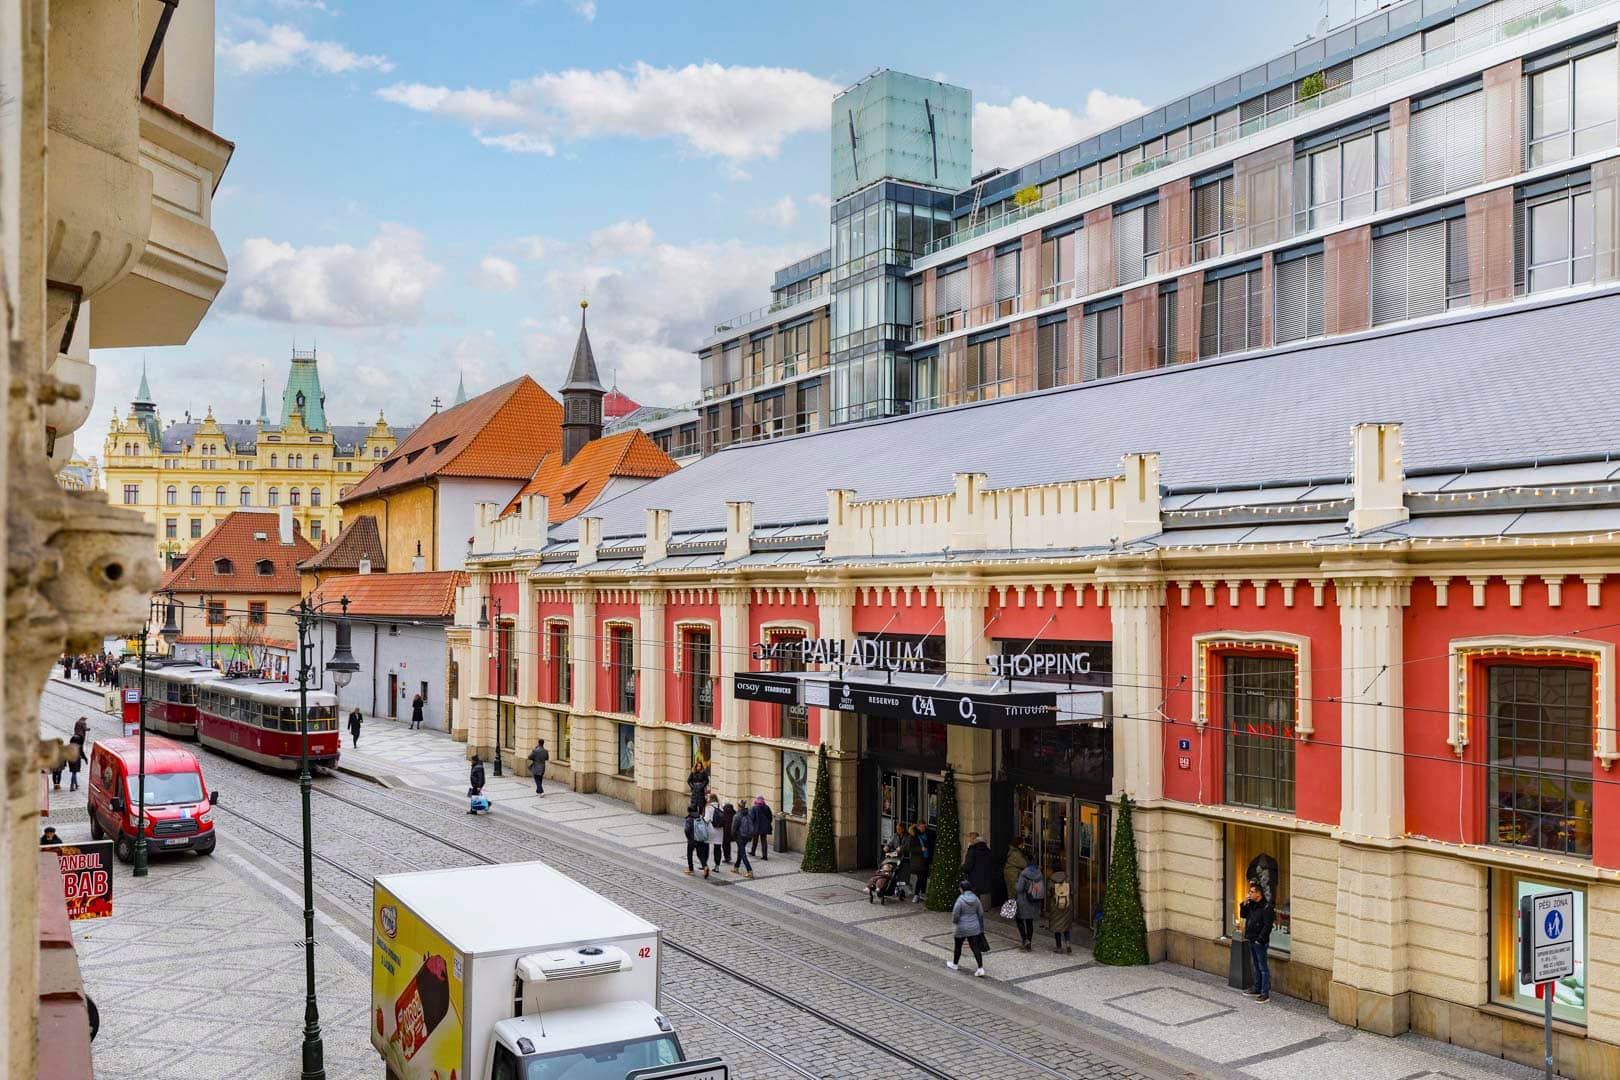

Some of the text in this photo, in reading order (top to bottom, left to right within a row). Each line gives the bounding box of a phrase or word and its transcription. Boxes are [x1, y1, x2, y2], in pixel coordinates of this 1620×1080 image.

[801, 638, 926, 673] PALLADIUM
[986, 652, 1091, 676] SHOPPING
[737, 681, 760, 695] orsay
[868, 696, 900, 706] RESERVED
[912, 695, 937, 717] C&A
[959, 696, 977, 725] O2
[63, 870, 108, 899] BAB
[638, 947, 651, 958] 42
